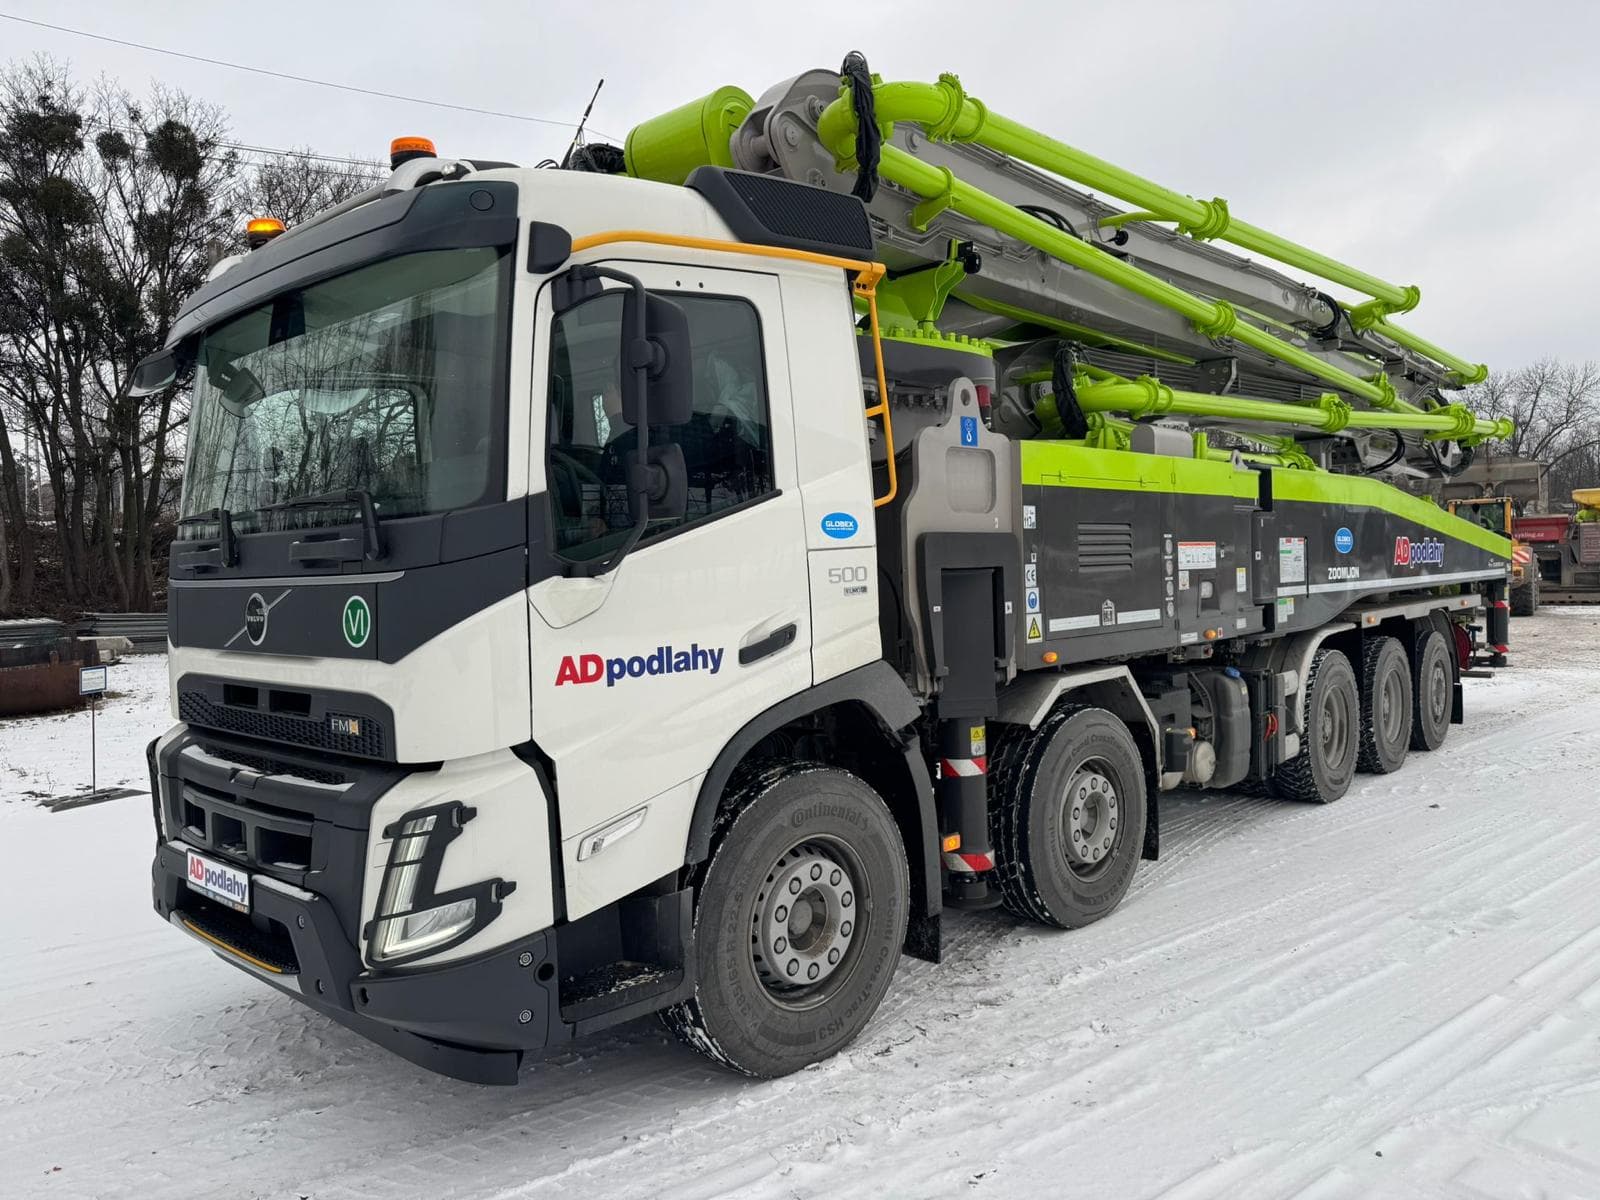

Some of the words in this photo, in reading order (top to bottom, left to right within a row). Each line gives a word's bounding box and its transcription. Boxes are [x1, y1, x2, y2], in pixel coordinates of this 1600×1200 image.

[825, 520, 854, 528] GLOBEX
[828, 566, 868, 584] 500
[1328, 566, 1360, 580] ZOOMLION
[347, 608, 365, 636] VI
[791, 801, 863, 828] Continental
